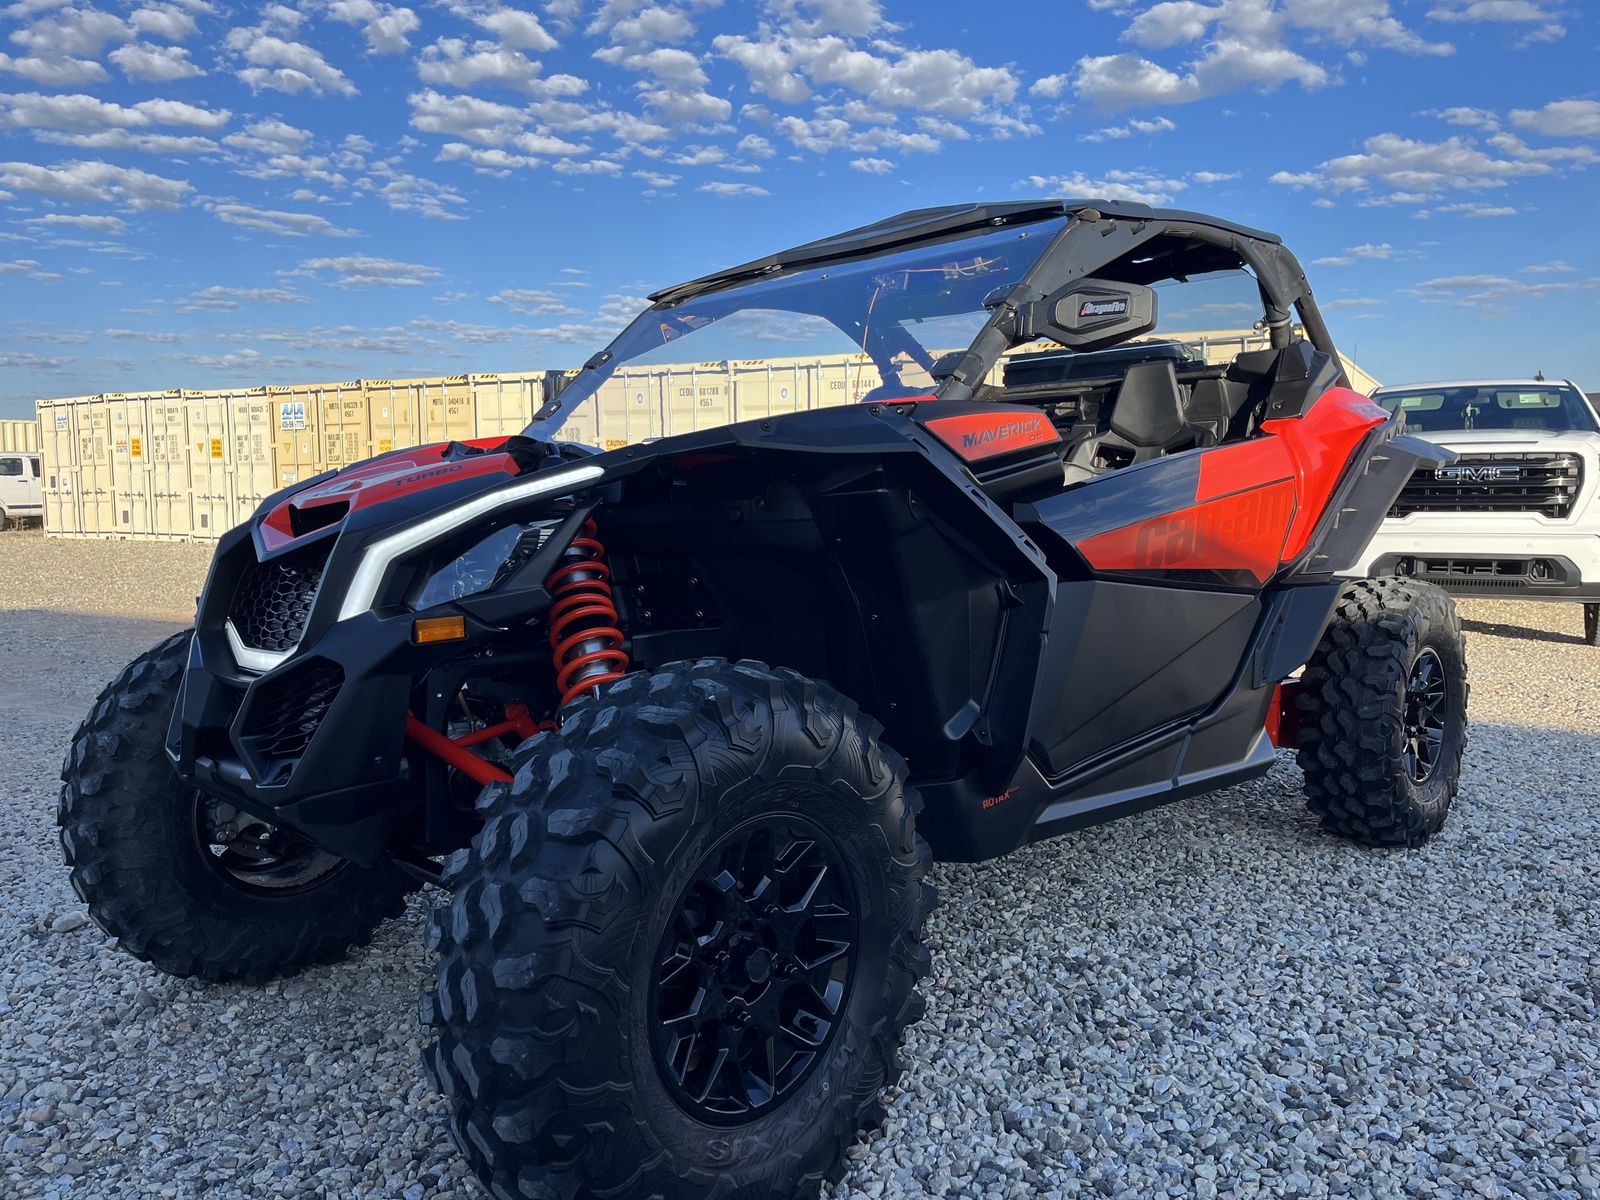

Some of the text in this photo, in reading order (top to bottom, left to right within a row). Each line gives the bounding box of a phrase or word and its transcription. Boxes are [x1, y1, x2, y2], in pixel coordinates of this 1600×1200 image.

[1084, 301, 1126, 315] DragonFire
[961, 418, 1042, 448] MAVERICK
[396, 464, 464, 486] TURBO
[1434, 466, 1520, 481] GMC
[982, 790, 1010, 810] ROTAX
